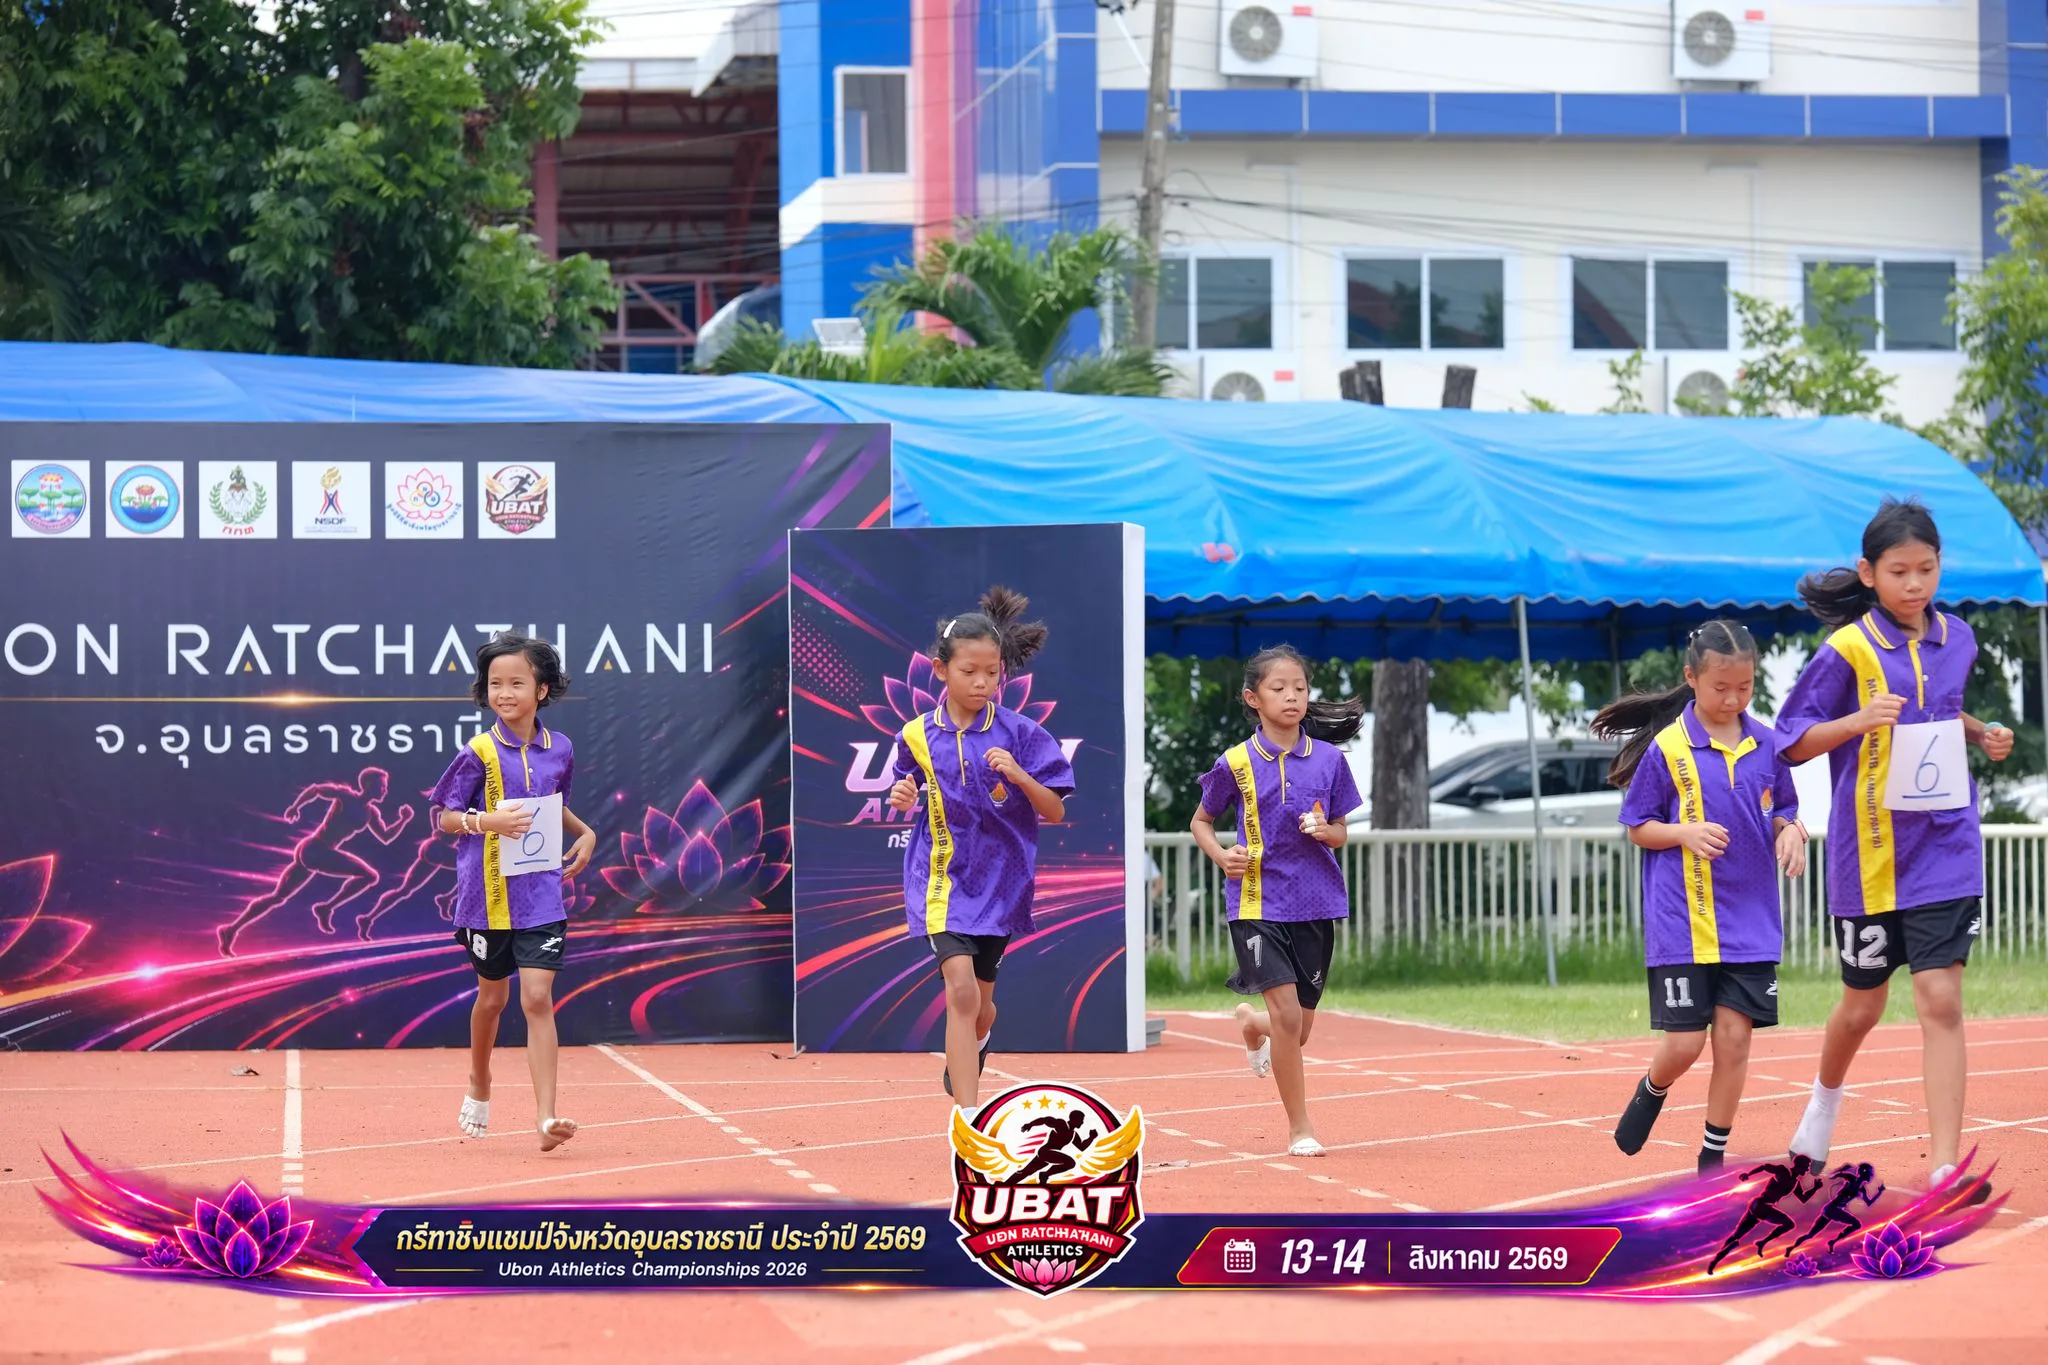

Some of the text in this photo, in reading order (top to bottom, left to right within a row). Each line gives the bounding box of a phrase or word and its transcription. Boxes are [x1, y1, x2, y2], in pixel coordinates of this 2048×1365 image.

[491, 500, 543, 516] UBAT
[1915, 734, 1940, 793] 6
[523, 807, 544, 856] 6
[472, 933, 488, 961] 8
[1246, 934, 1263, 968] 7
[1841, 919, 1888, 969] 12
[1664, 977, 1694, 1008] 11
